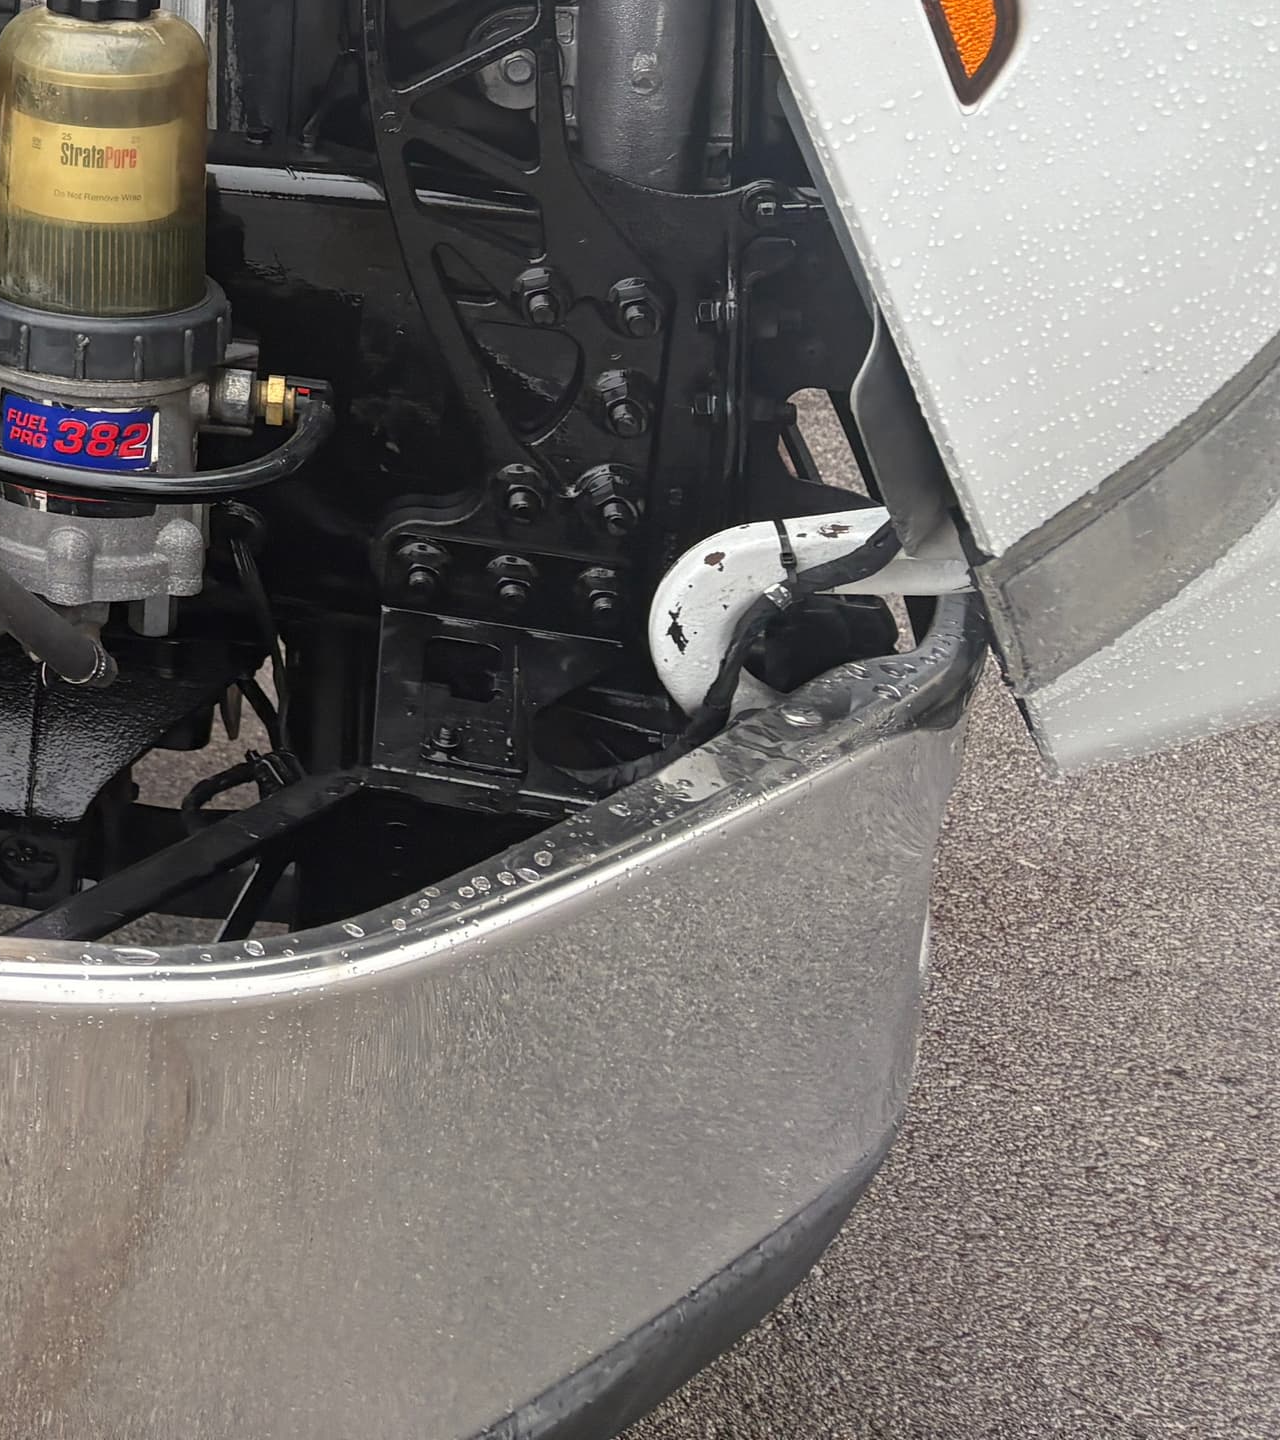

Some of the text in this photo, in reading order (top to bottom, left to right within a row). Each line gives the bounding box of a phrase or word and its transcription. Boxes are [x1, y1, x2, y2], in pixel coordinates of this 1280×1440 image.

[60, 141, 137, 169] StrataPore
[54, 188, 142, 202] Do Not Remove Wrap
[6, 408, 151, 460] FUEL 382
[9, 426, 48, 449] PRO
